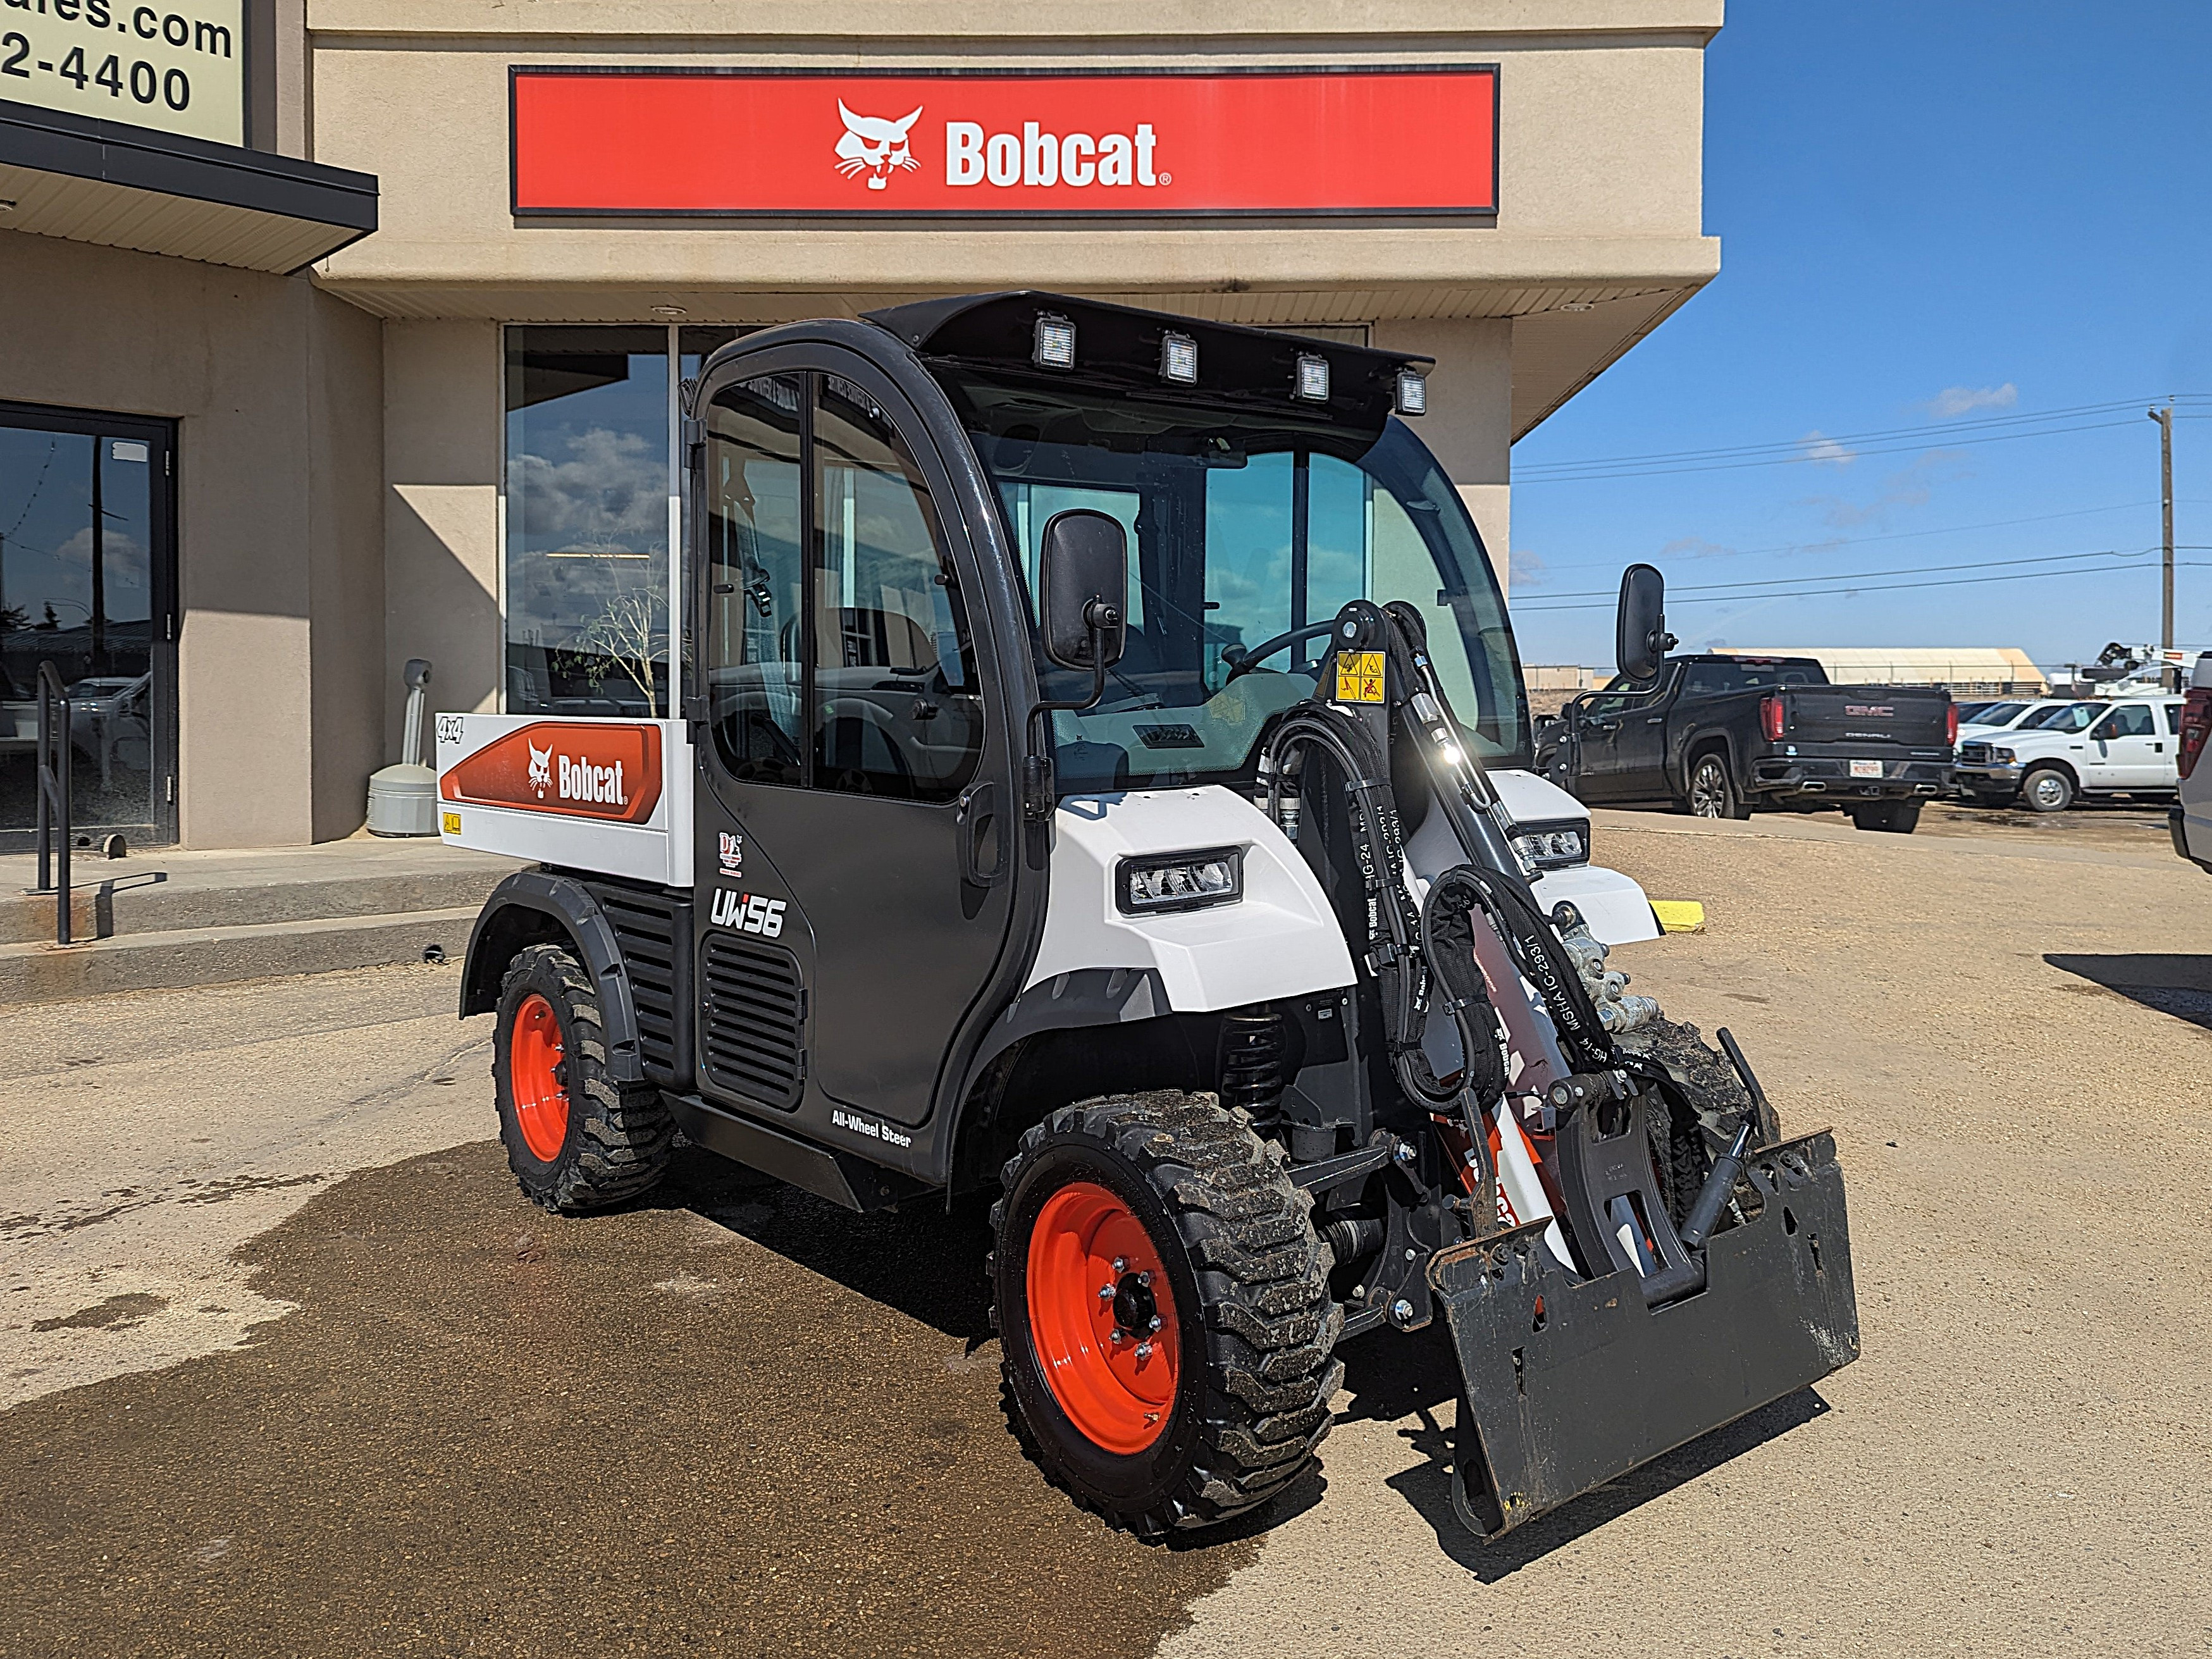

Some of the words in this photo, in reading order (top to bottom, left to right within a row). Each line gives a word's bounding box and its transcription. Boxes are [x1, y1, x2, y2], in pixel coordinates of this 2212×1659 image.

[4, 0, 231, 58] es.com
[1, 32, 190, 111] 2-4400
[946, 121, 1156, 187] Bobcat
[436, 716, 464, 744] 4x4
[1845, 705, 1894, 717] GMC
[559, 755, 624, 805] Bobcat
[1367, 897, 1378, 928] Bobcat
[1524, 935, 1559, 991] IC-293/1
[1553, 990, 1581, 1031] MSHA
[832, 1109, 879, 1138] All-Wheel
[882, 1125, 911, 1148] Steer
